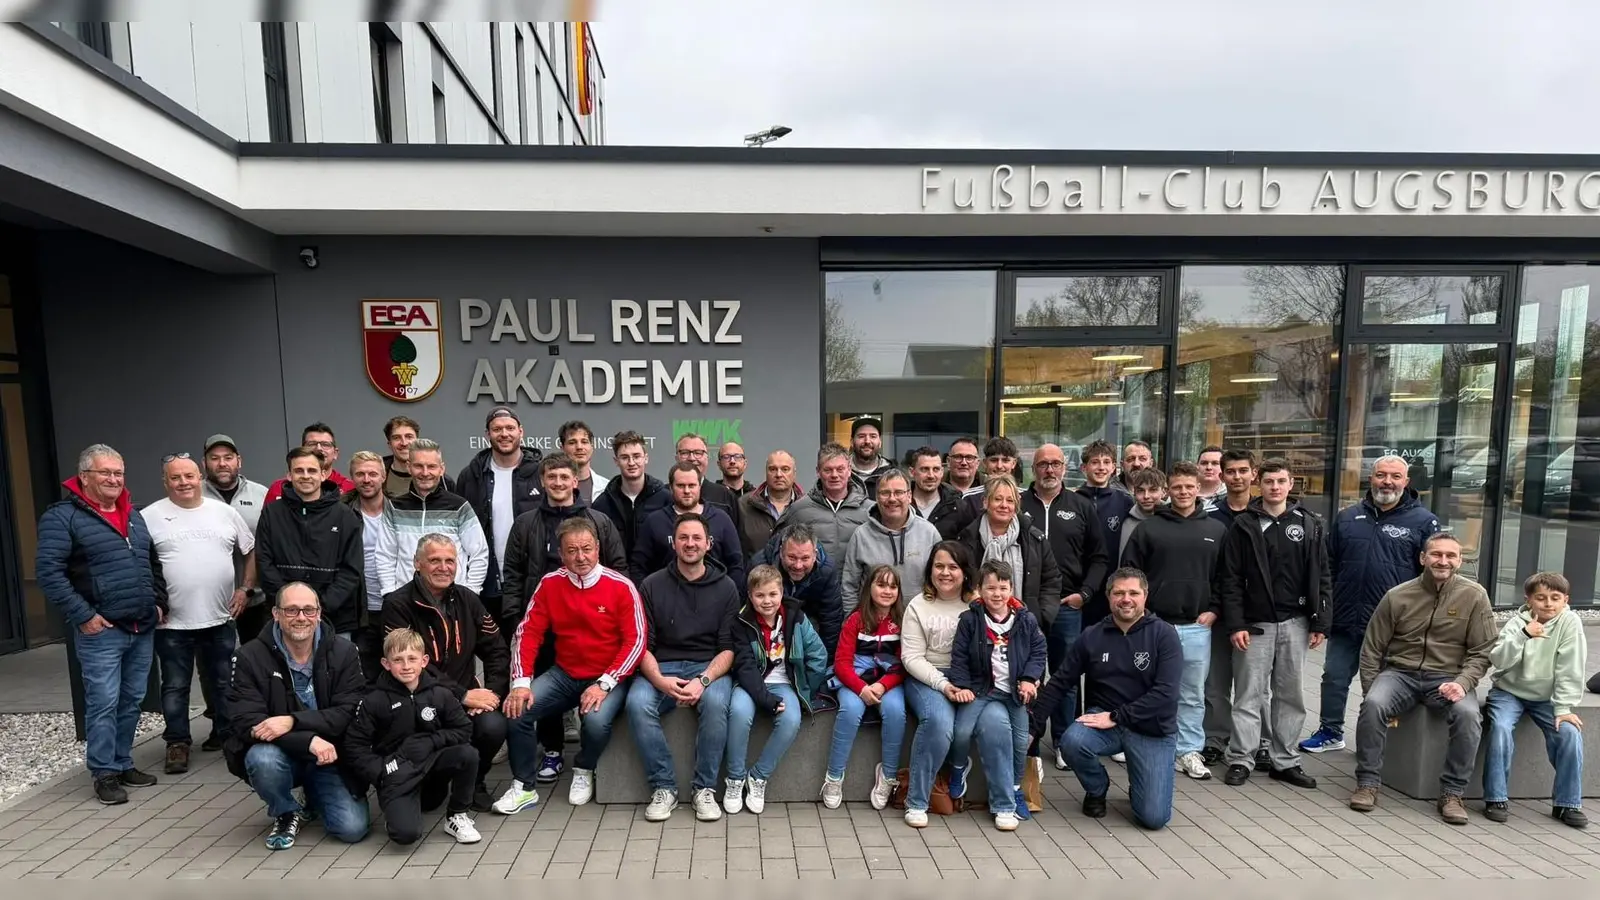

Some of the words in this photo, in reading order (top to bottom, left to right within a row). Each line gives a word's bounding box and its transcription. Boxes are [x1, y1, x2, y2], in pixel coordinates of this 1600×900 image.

[921, 164, 1282, 210] Fußball-Club
[459, 298, 596, 343] PAUL
[611, 299, 743, 344] RENZ
[394, 386, 418, 396] 1907
[466, 358, 744, 404] AKADEMIE
